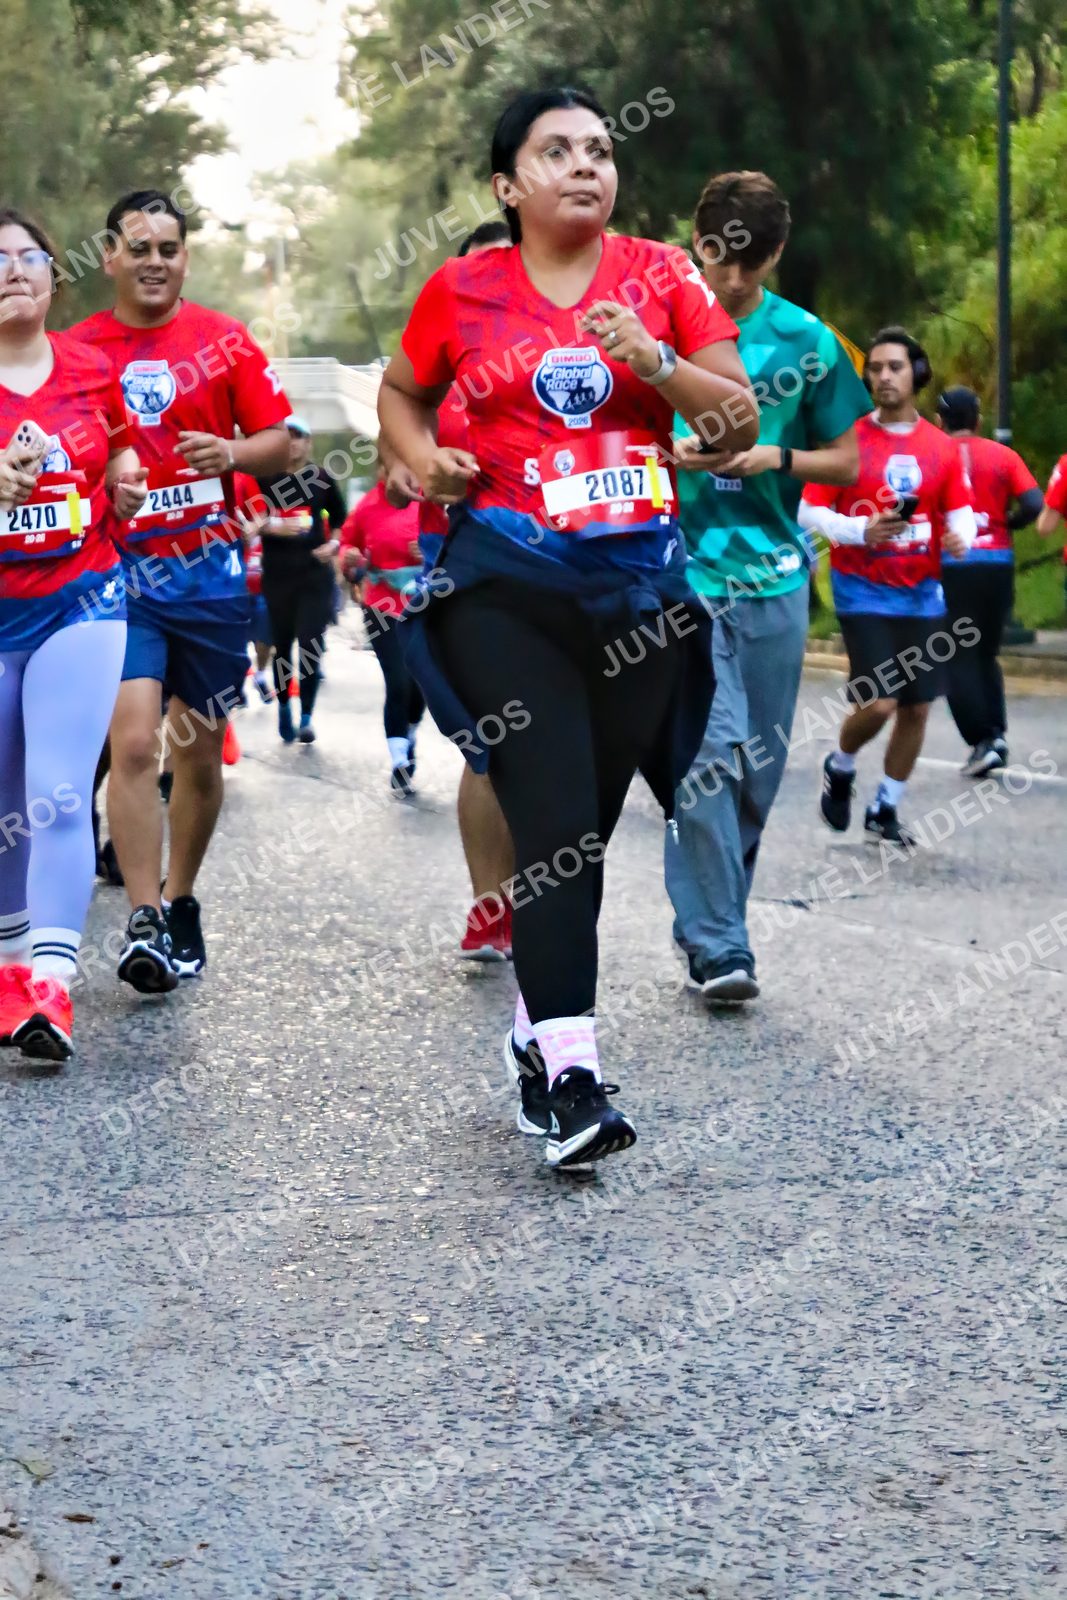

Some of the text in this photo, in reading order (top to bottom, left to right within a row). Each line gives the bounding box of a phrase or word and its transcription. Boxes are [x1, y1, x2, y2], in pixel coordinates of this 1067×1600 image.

[546, 379, 578, 391] Race
[553, 366, 593, 380] Global
[149, 485, 194, 511] 2444
[585, 469, 644, 501] 2087
[7, 504, 58, 532] 2470
